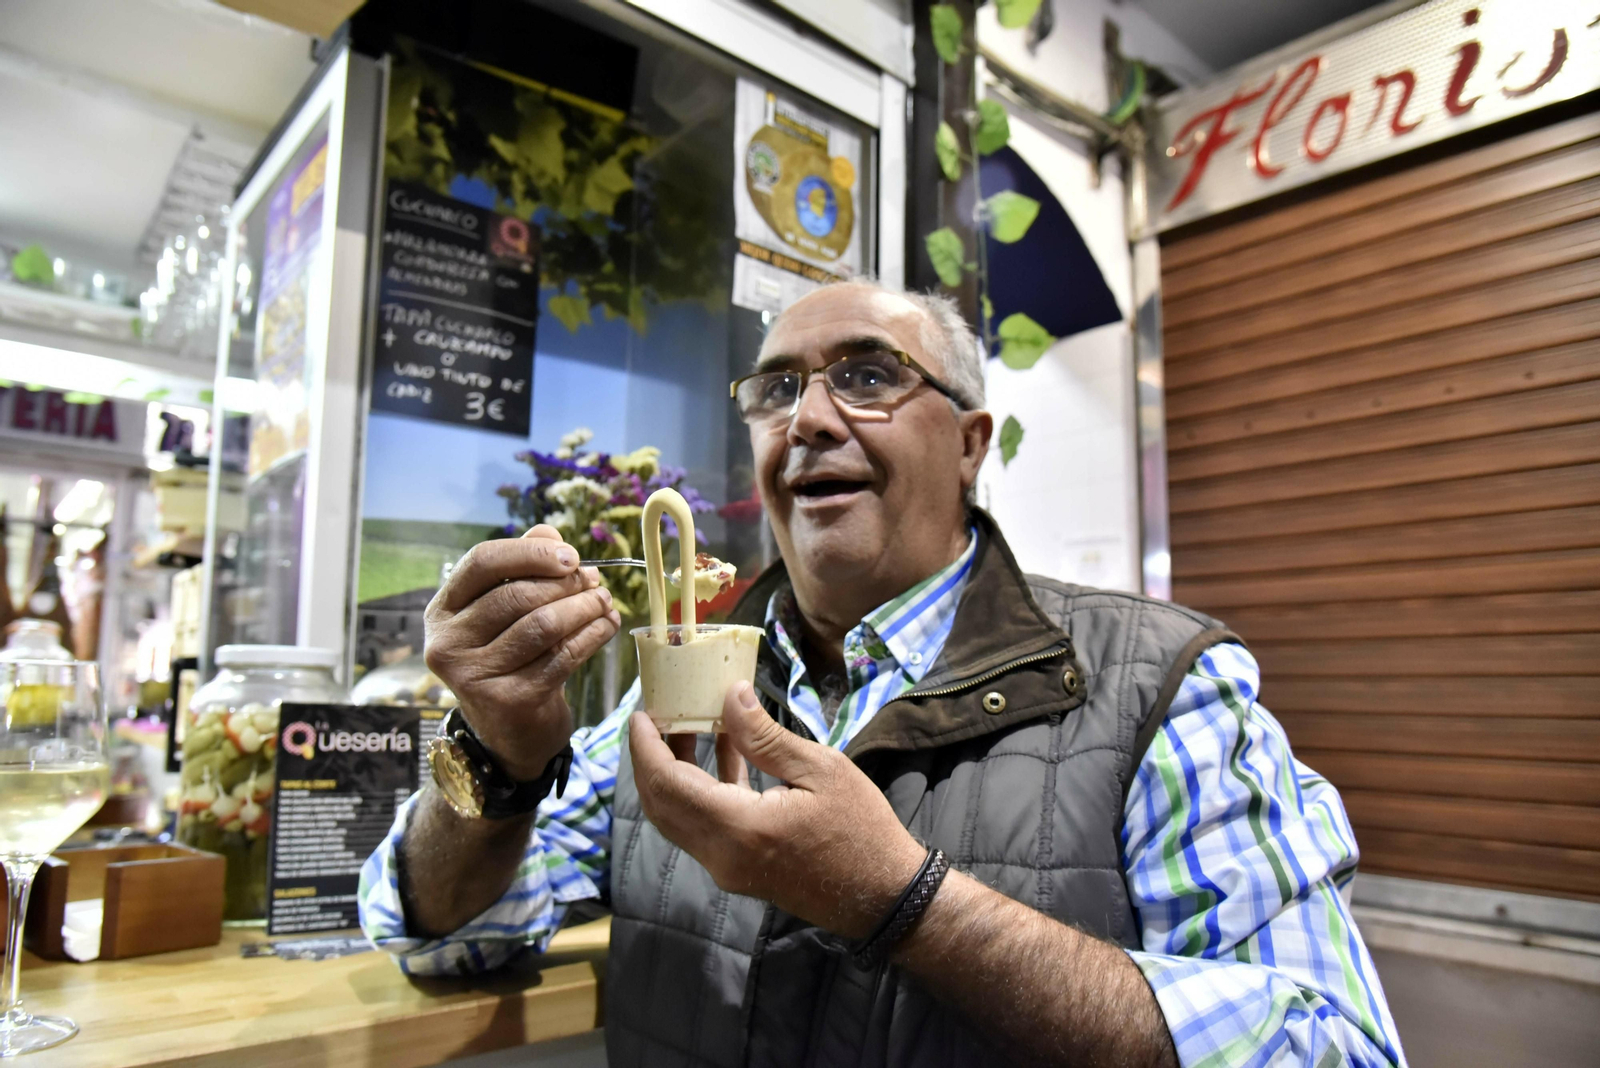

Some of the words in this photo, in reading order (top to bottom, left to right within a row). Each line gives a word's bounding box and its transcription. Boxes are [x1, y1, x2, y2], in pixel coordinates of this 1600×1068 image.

[1166, 8, 1600, 213] Floris
[382, 302, 431, 327] TAPA
[393, 361, 436, 380] VINO
[440, 366, 493, 389] TINTO
[500, 377, 527, 394] DE
[0, 382, 117, 444] ERIA
[463, 391, 506, 421] 3€
